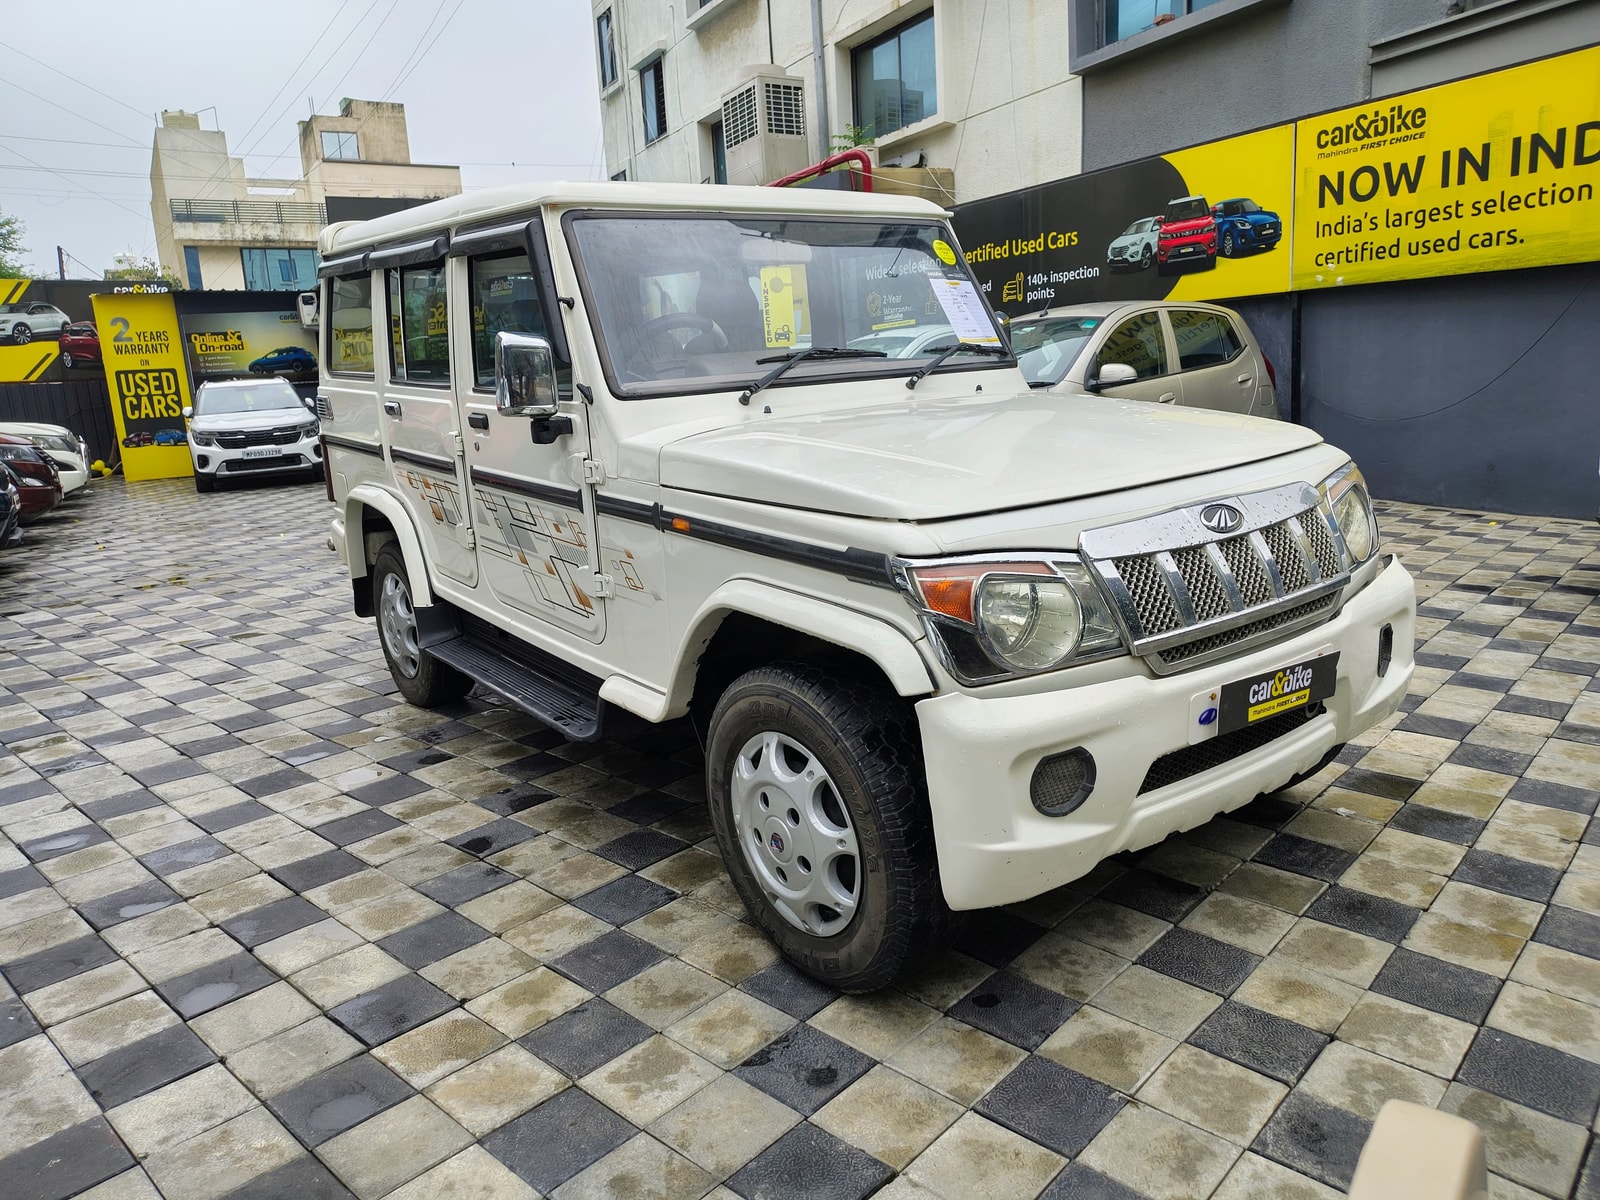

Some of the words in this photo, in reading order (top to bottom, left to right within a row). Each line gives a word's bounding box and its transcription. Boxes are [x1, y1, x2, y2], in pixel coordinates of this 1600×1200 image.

[1317, 105, 1427, 149] car&bike
[1318, 147, 1358, 160] Mahindra
[1360, 140, 1389, 151] FIRST
[1389, 132, 1426, 146] CHOICE
[1318, 155, 1426, 208] NOW
[1440, 142, 1491, 188] IN
[1315, 211, 1378, 238] India's
[1385, 200, 1464, 230] largest
[1471, 182, 1593, 217] selection
[964, 239, 1009, 264] ertified
[1012, 234, 1045, 256] Used
[1048, 230, 1079, 249] Cars
[1315, 238, 1401, 267] certified
[1407, 230, 1460, 256] used
[1469, 228, 1525, 249] cars.
[1027, 273, 1049, 286] 140+
[1050, 265, 1099, 285] inspection
[1026, 287, 1055, 303] points
[763, 281, 773, 343] INSPECTED
[110, 317, 133, 342] 2
[135, 331, 169, 342] YEARS
[191, 332, 224, 344] Online
[113, 343, 170, 355] WARRANTY
[200, 343, 244, 353] On-road
[120, 372, 176, 396] USED
[124, 394, 181, 419] CARS
[1249, 665, 1313, 704] car&bike
